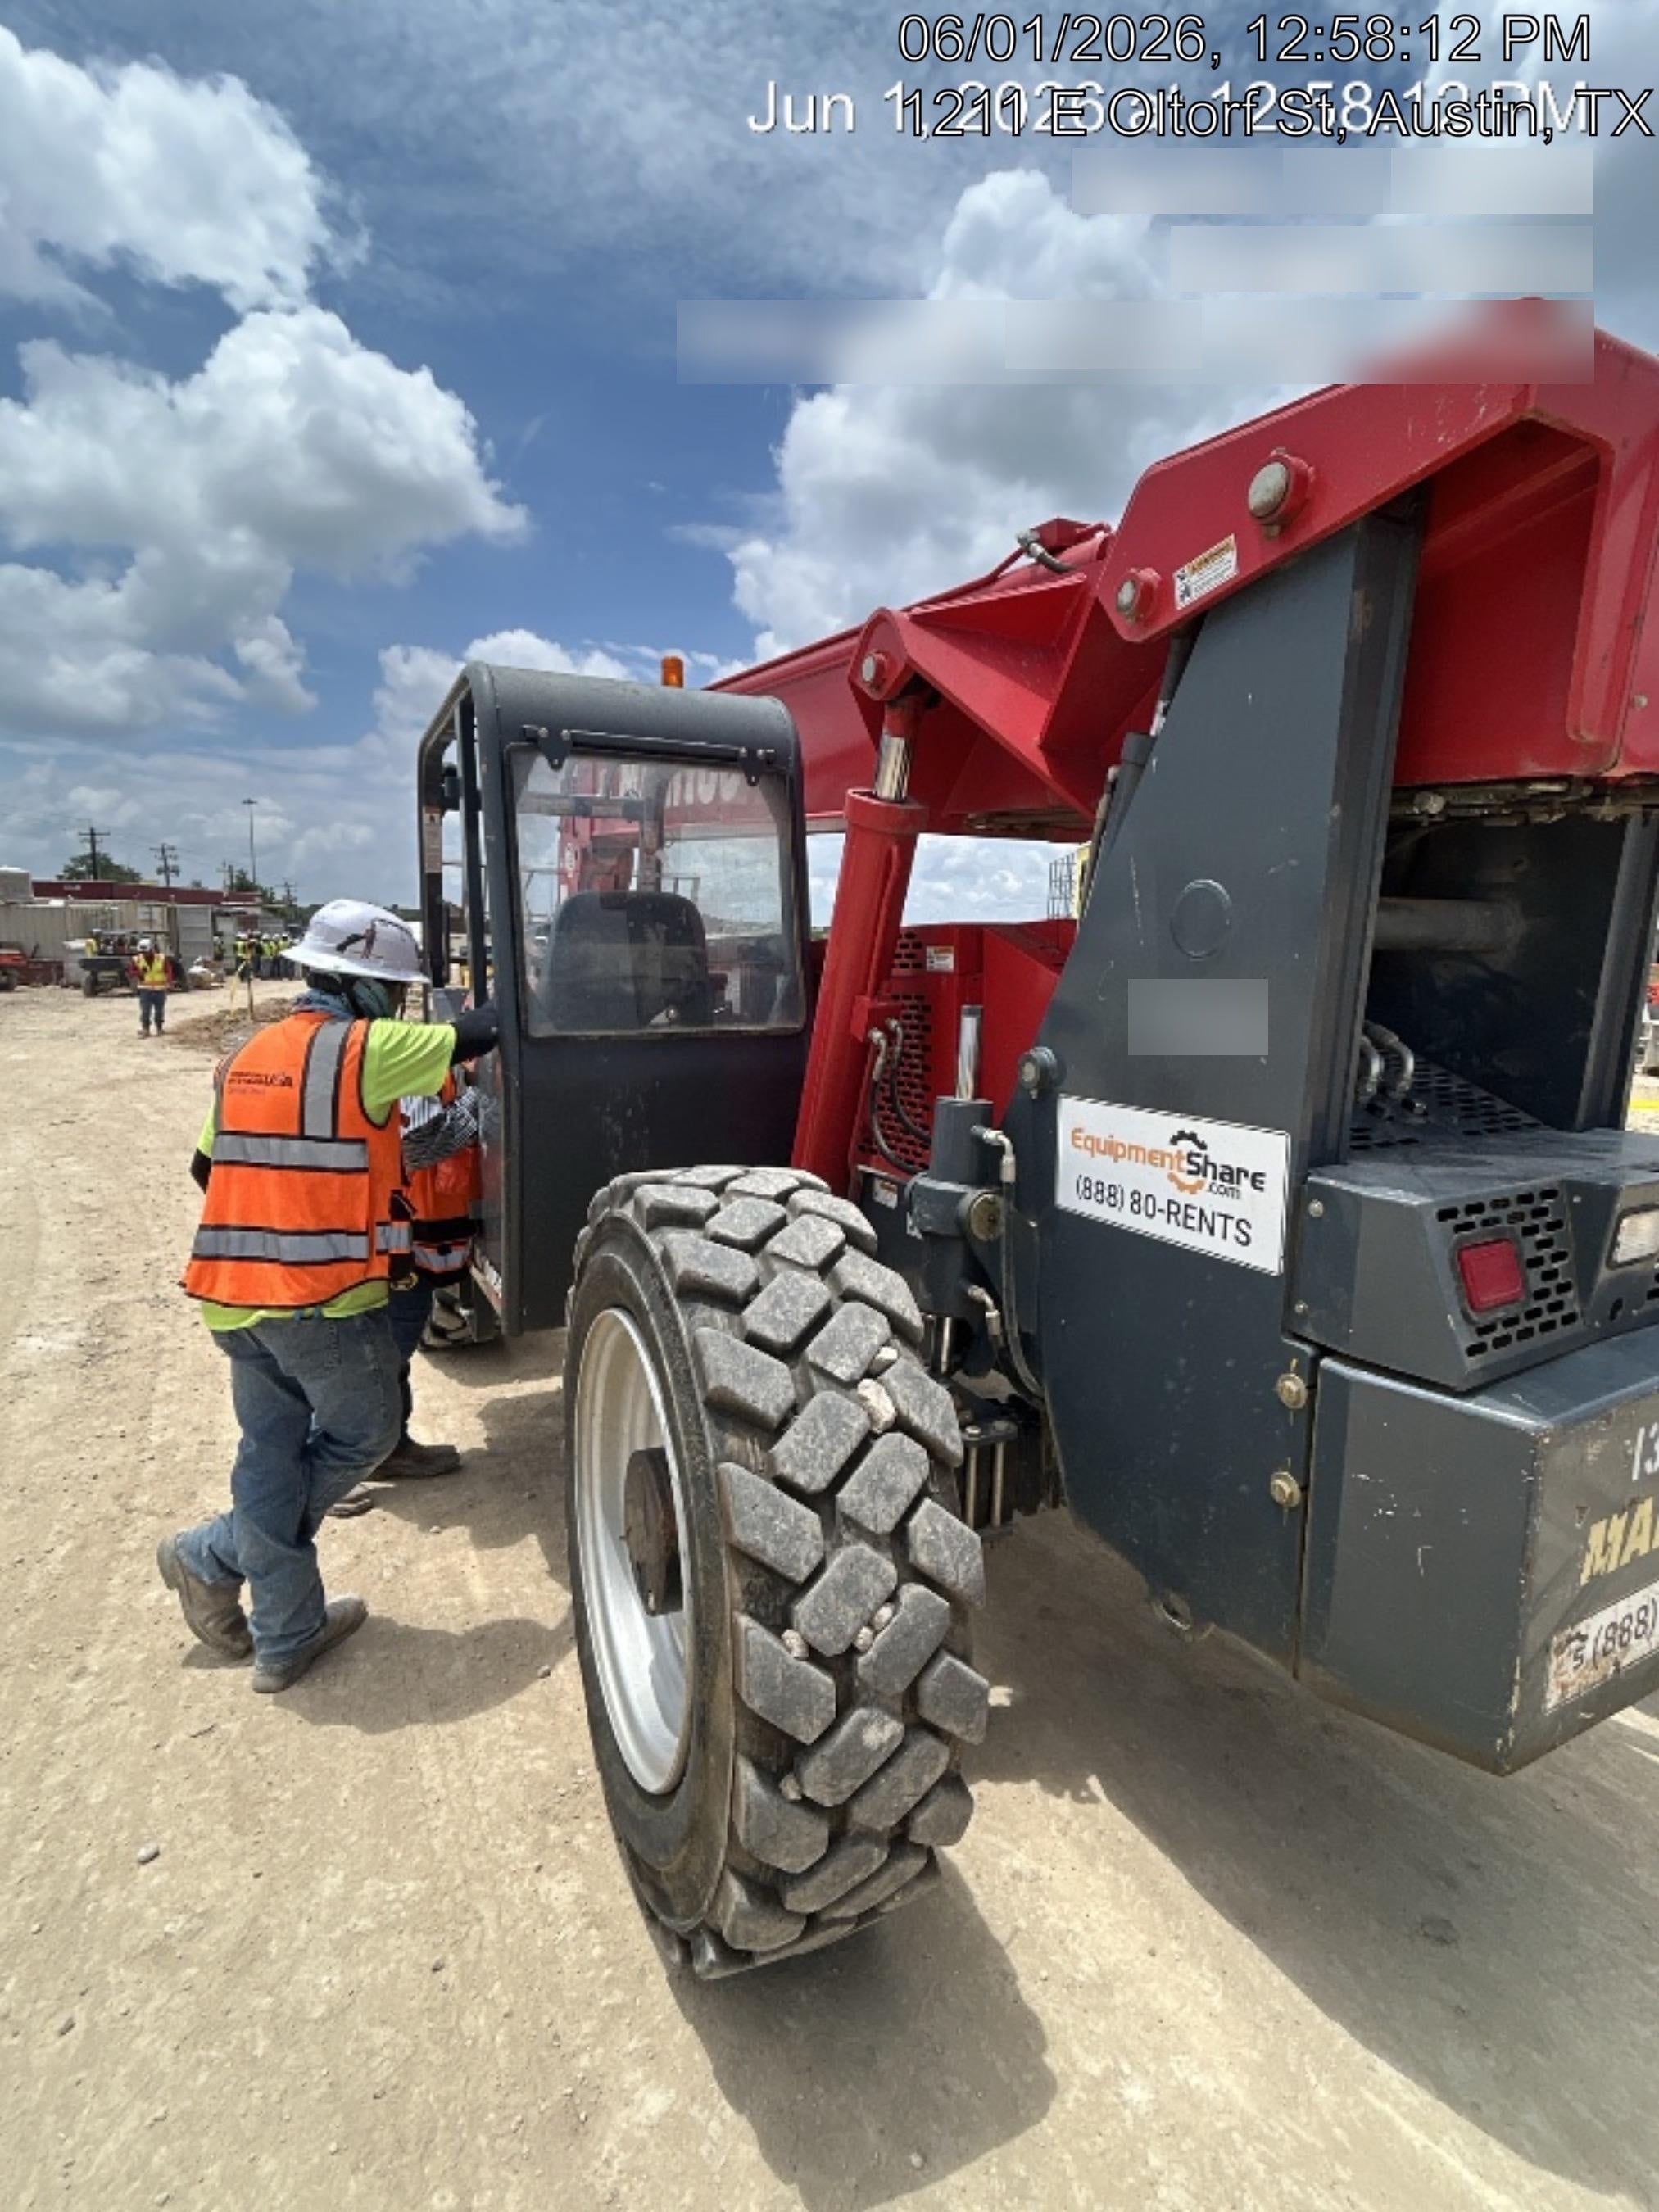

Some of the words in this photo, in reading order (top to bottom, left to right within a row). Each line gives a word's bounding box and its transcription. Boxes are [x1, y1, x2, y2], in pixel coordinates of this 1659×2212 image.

[1071, 1127, 1267, 1192] EquipmentShare
[1076, 1174, 1125, 1212] (888)
[1130, 1190, 1253, 1248] 80-RENTS
[1580, 1496, 1659, 1587] MA
[1593, 1598, 1658, 1670] (888)
